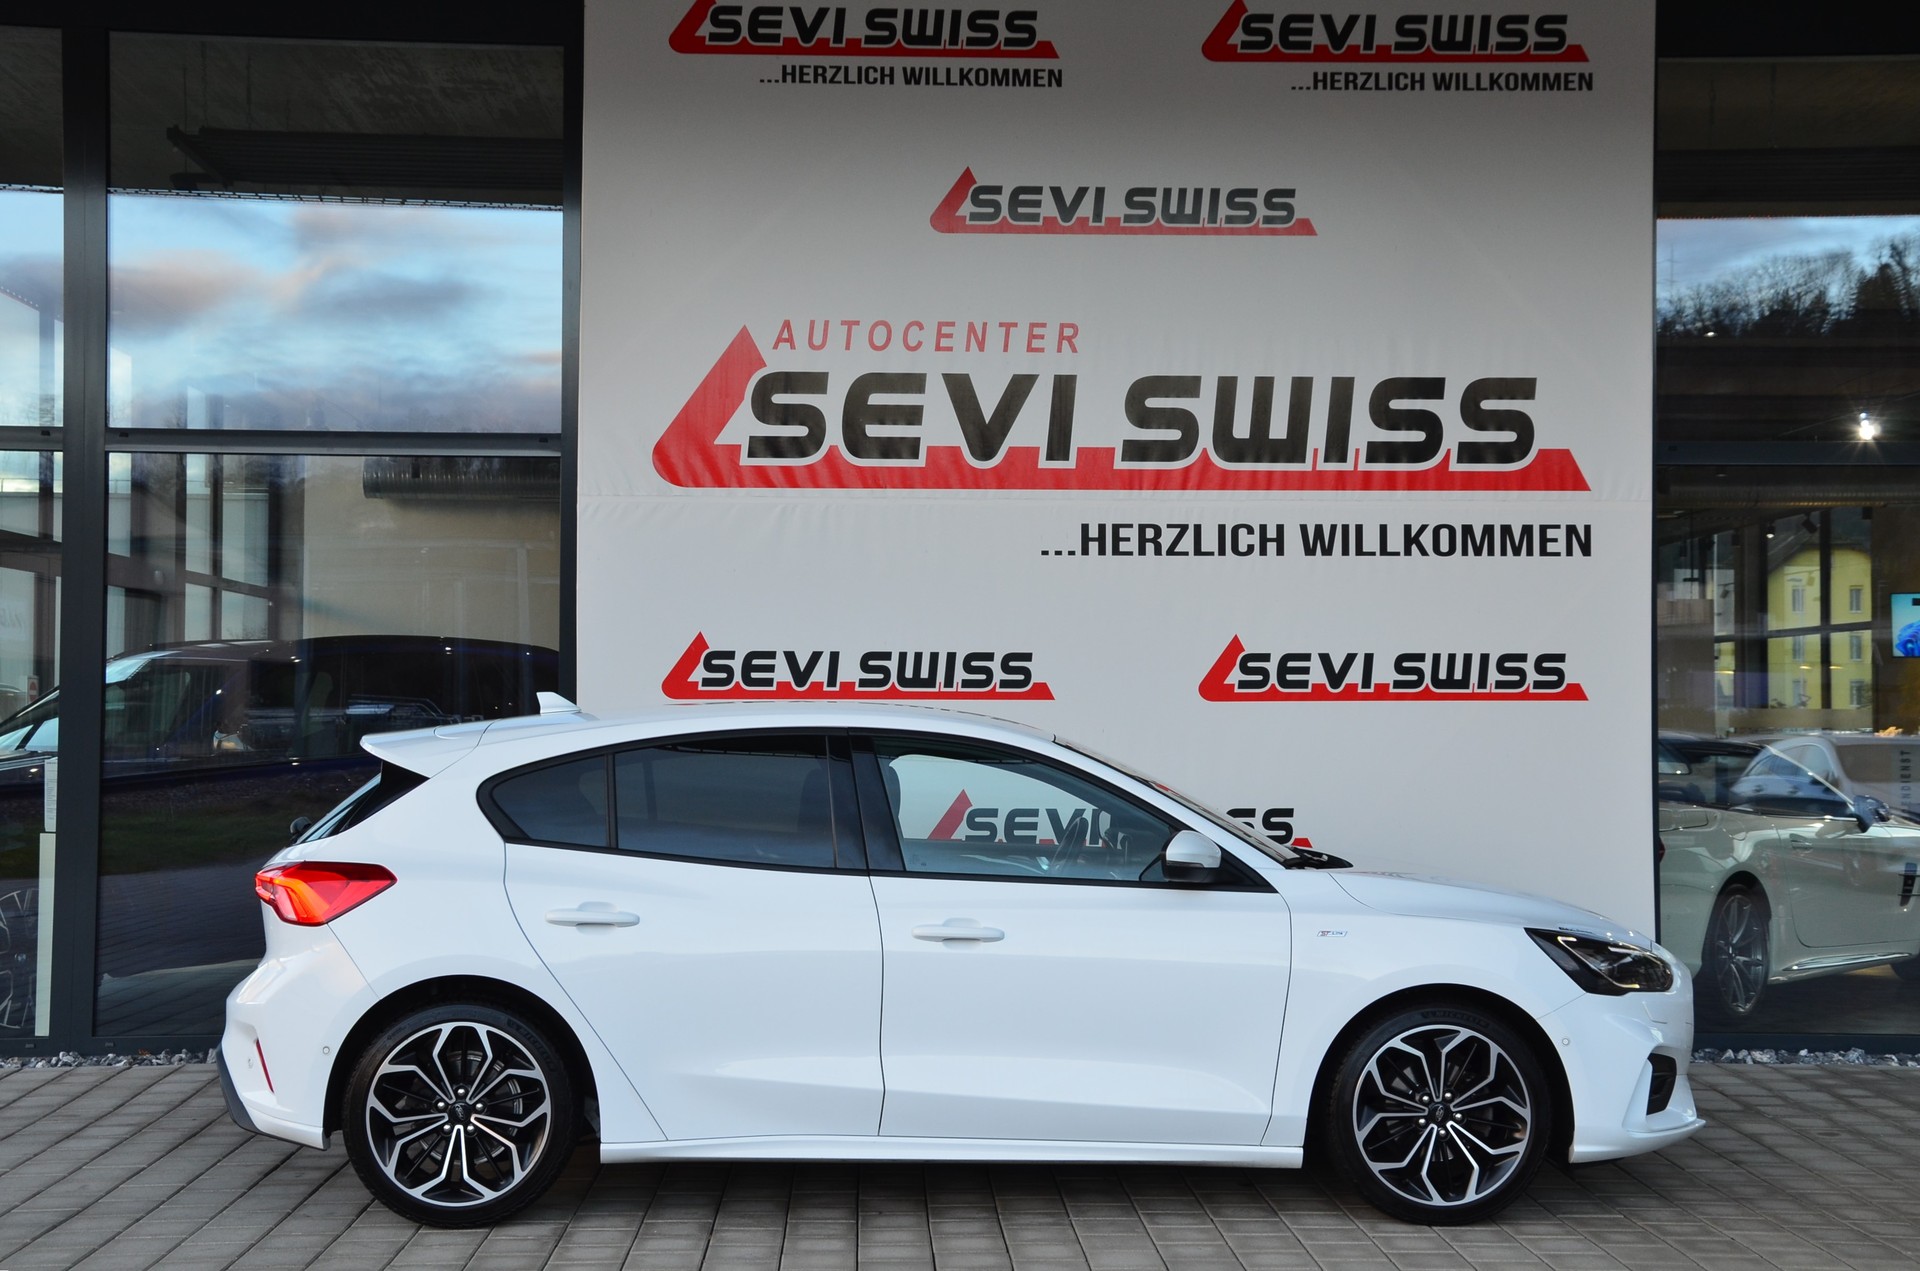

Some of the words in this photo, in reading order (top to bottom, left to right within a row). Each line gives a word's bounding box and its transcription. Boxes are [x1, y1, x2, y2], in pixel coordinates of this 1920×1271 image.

[709, 6, 846, 44] SEVI
[864, 8, 1037, 47] SWISS
[1241, 14, 1376, 51] SEVI
[1394, 15, 1567, 52] SWISS
[760, 65, 894, 84] ...HERZLICH
[903, 67, 1062, 87] WILLKOMMEN
[1292, 72, 1424, 90] ...HERZLICH
[1433, 73, 1592, 91] WILLKOMMEN
[969, 185, 1105, 223] SEVI
[1124, 187, 1296, 224] SWISS
[772, 320, 1080, 352] AUTOCENTER
[748, 372, 1077, 461] SEVI
[1122, 376, 1537, 464] SWISS
[1041, 524, 1284, 556] ...HERZLICH
[1300, 524, 1591, 556] WILLKOMMEN
[702, 651, 839, 687] SEVI
[858, 652, 1032, 688] SWISS
[1238, 653, 1374, 689] SEVI
[1393, 653, 1566, 689] SWISS
[965, 808, 1100, 845] SEVI
